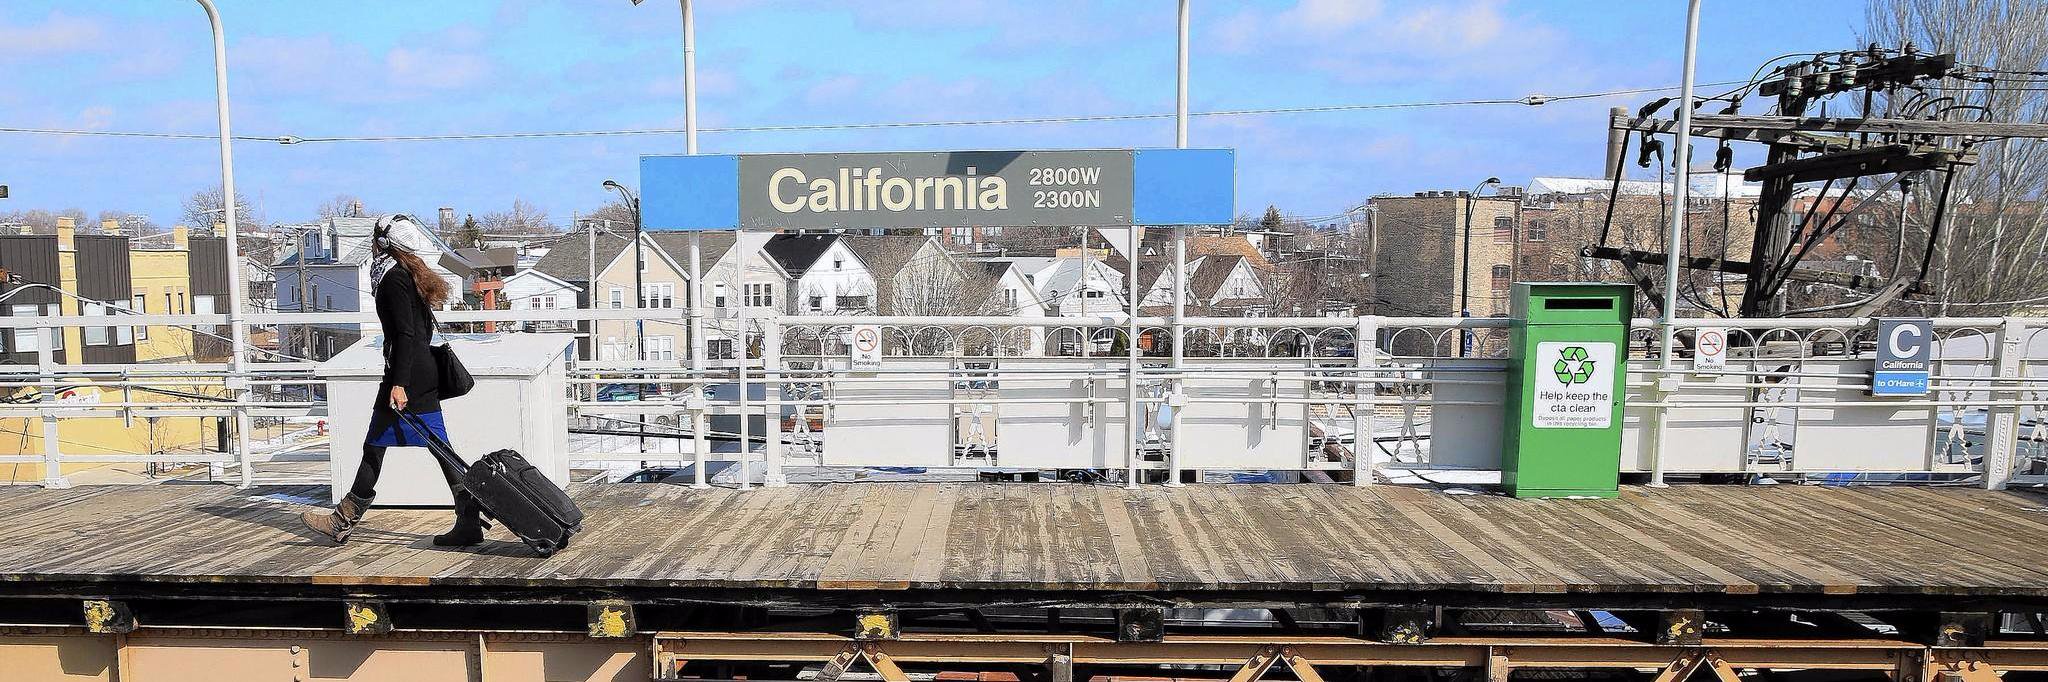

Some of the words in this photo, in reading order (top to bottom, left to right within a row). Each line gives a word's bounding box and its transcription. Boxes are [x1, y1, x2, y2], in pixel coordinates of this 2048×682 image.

[1029, 167, 1101, 186] 2800W
[768, 166, 1008, 213] California
[1033, 190, 1100, 208] 2300N
[1889, 323, 1921, 359] C
[1882, 361, 1923, 369] California
[1540, 391, 1563, 402] Help
[1566, 391, 1590, 402] keep
[1592, 391, 1608, 400] the
[1551, 404, 1566, 412] cta
[1569, 404, 1596, 412] clean
